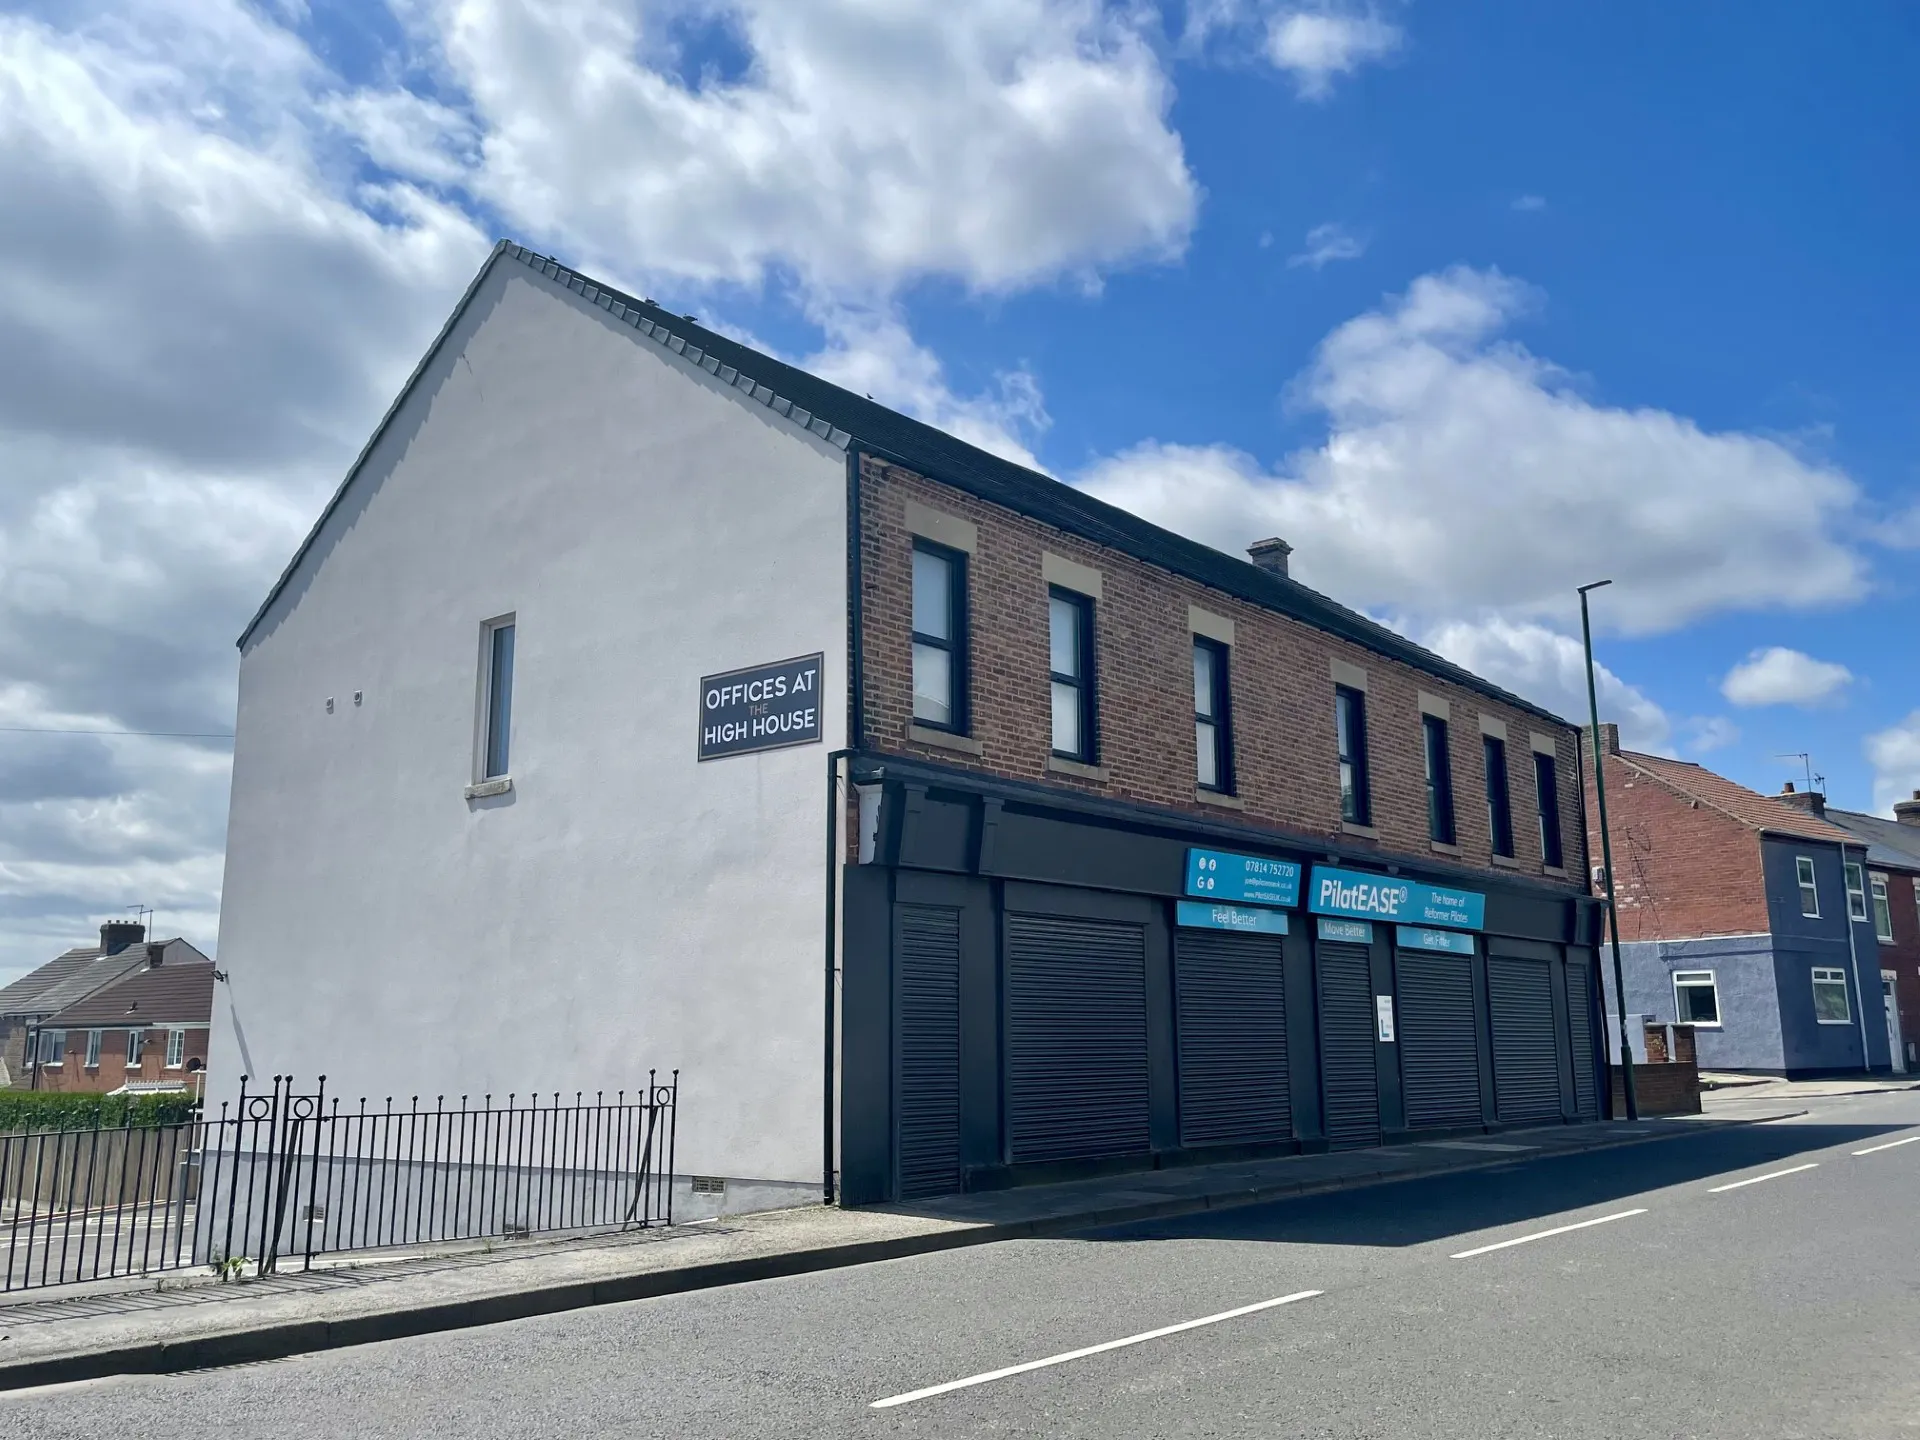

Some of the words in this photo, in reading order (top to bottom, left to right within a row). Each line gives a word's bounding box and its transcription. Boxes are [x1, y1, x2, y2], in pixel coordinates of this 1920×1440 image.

[706, 676, 786, 709] OFFICES
[791, 670, 816, 694] AT
[749, 703, 768, 716] THE
[705, 720, 747, 745] HIGH
[752, 708, 815, 737] HOUSE
[1245, 860, 1268, 874] 07814
[1269, 864, 1294, 877] 752720
[1431, 892, 1441, 904] The
[1458, 897, 1466, 908] of
[1212, 909, 1230, 924] Feel
[1231, 911, 1257, 926] Better
[1424, 906, 1450, 920] Reformer
[1450, 910, 1468, 923] Pilates
[1325, 923, 1344, 936] Move
[1344, 924, 1365, 937] Better
[1423, 933, 1435, 946] Get
[1435, 934, 1451, 948] Fitter
